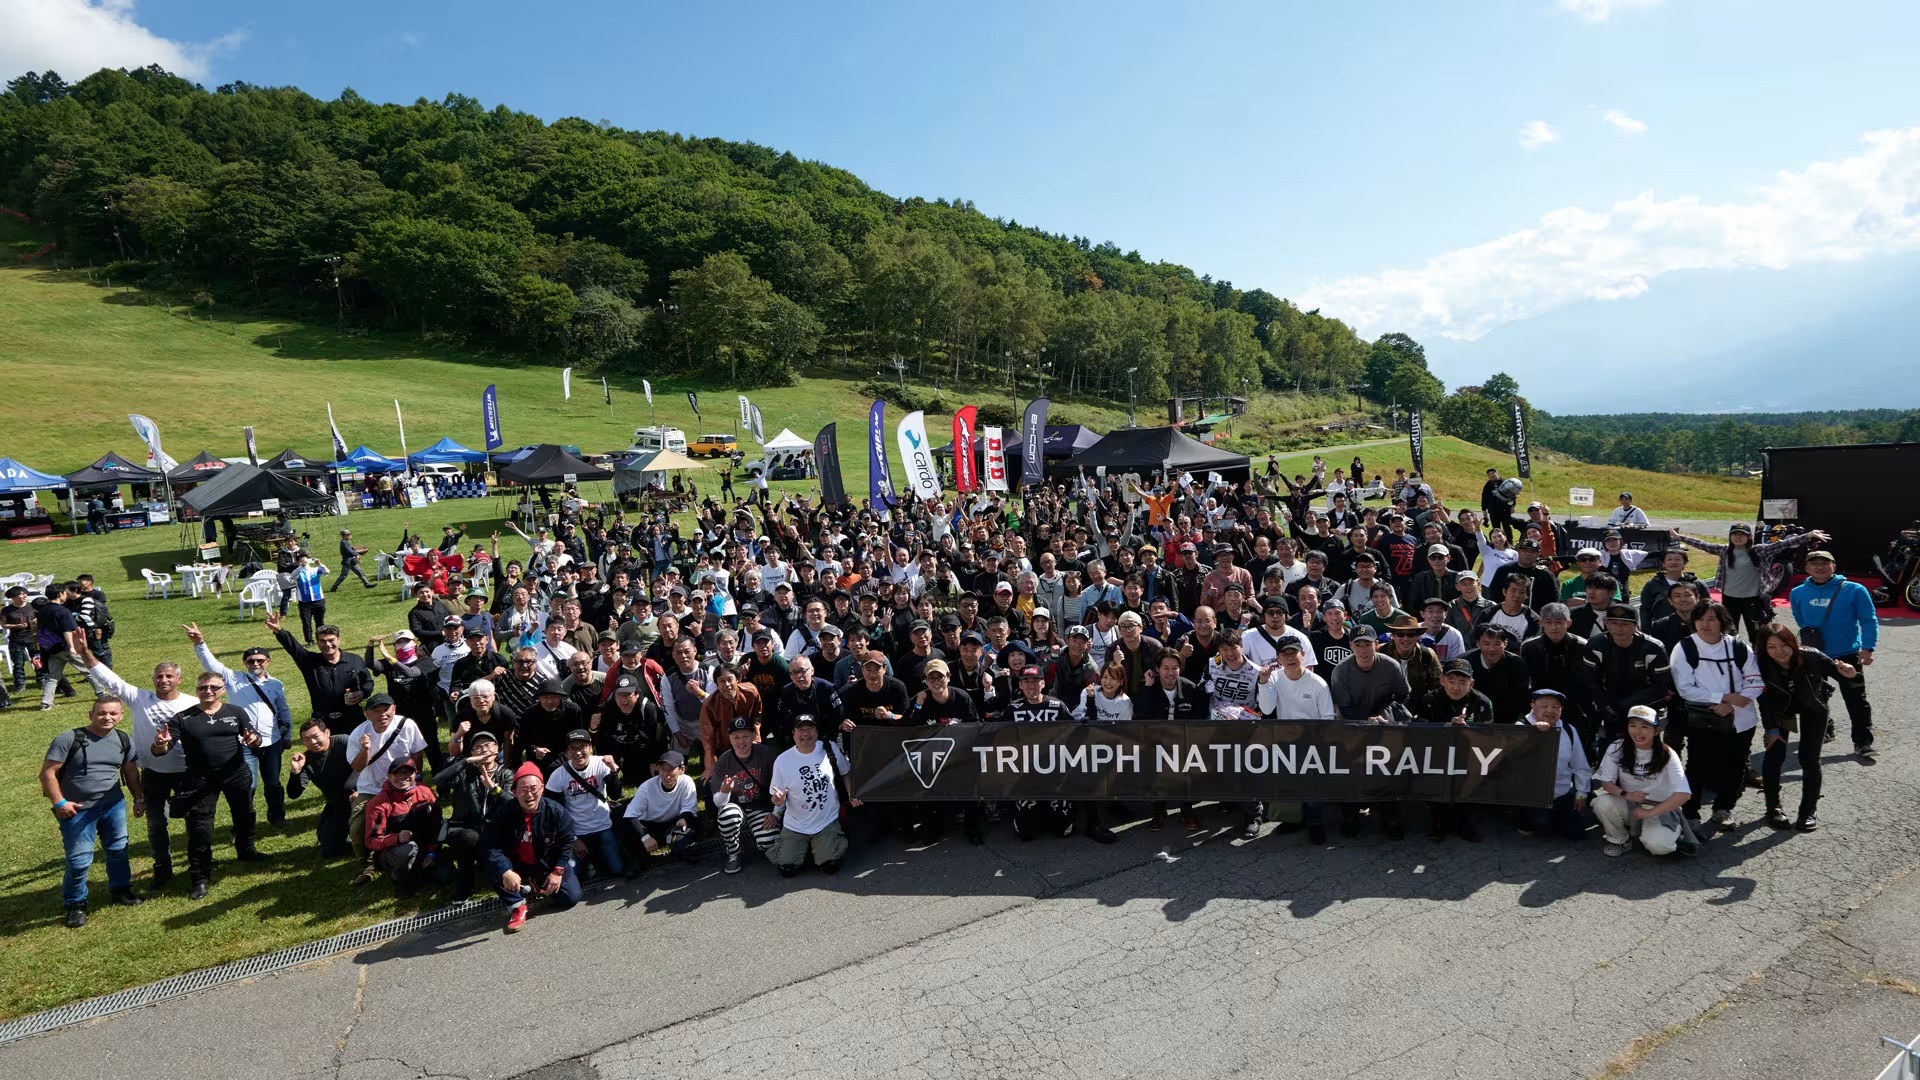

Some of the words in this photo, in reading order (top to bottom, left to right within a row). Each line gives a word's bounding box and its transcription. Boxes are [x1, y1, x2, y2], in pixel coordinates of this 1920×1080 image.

[485, 393, 495, 430] MICHELIN
[914, 451, 933, 489] cardo
[1013, 709, 1059, 722] FXR
[972, 744, 1140, 774] TRIUMPH
[1155, 743, 1350, 775] NATIONAL
[1365, 745, 1503, 776] RALLY
